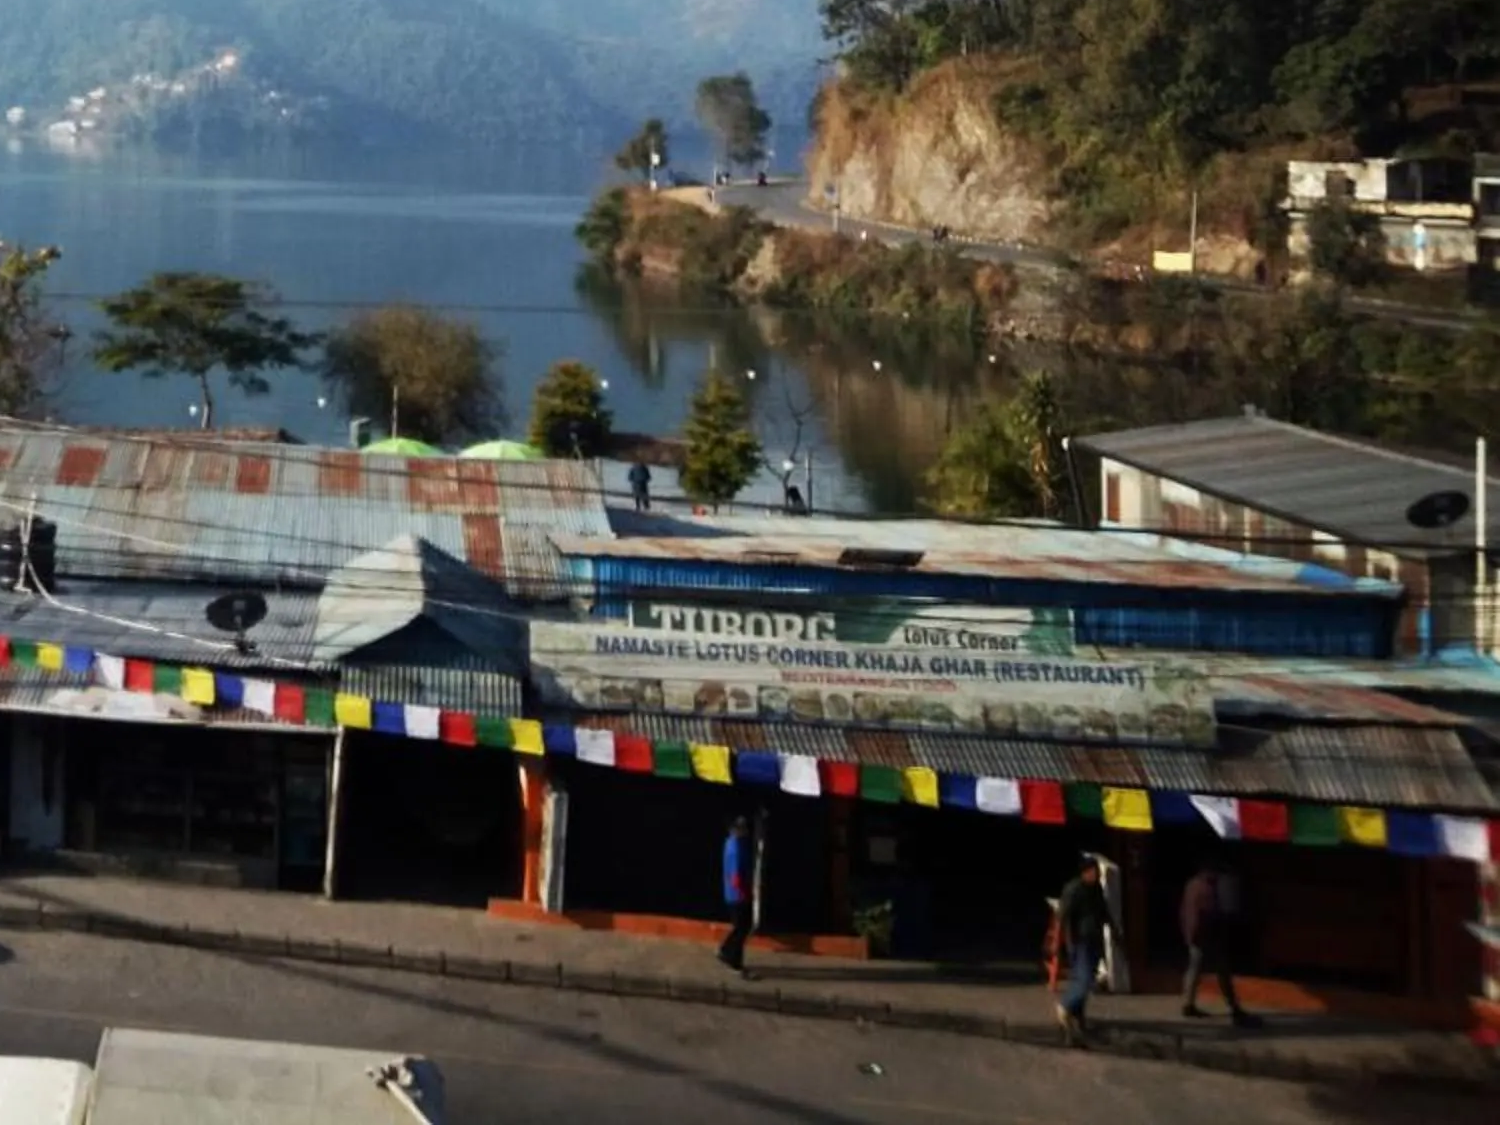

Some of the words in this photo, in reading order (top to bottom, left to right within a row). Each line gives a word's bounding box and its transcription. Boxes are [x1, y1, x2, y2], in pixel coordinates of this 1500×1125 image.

[903, 626, 949, 647] Lotus
[957, 629, 1017, 651] Corner
[596, 635, 690, 660] NAMASTE
[695, 641, 761, 663] LOTUS
[766, 645, 849, 669] CORNER
[854, 651, 924, 674] KHAJA
[929, 655, 987, 677] GHAR
[994, 660, 1145, 691] (RESTAURANT)
